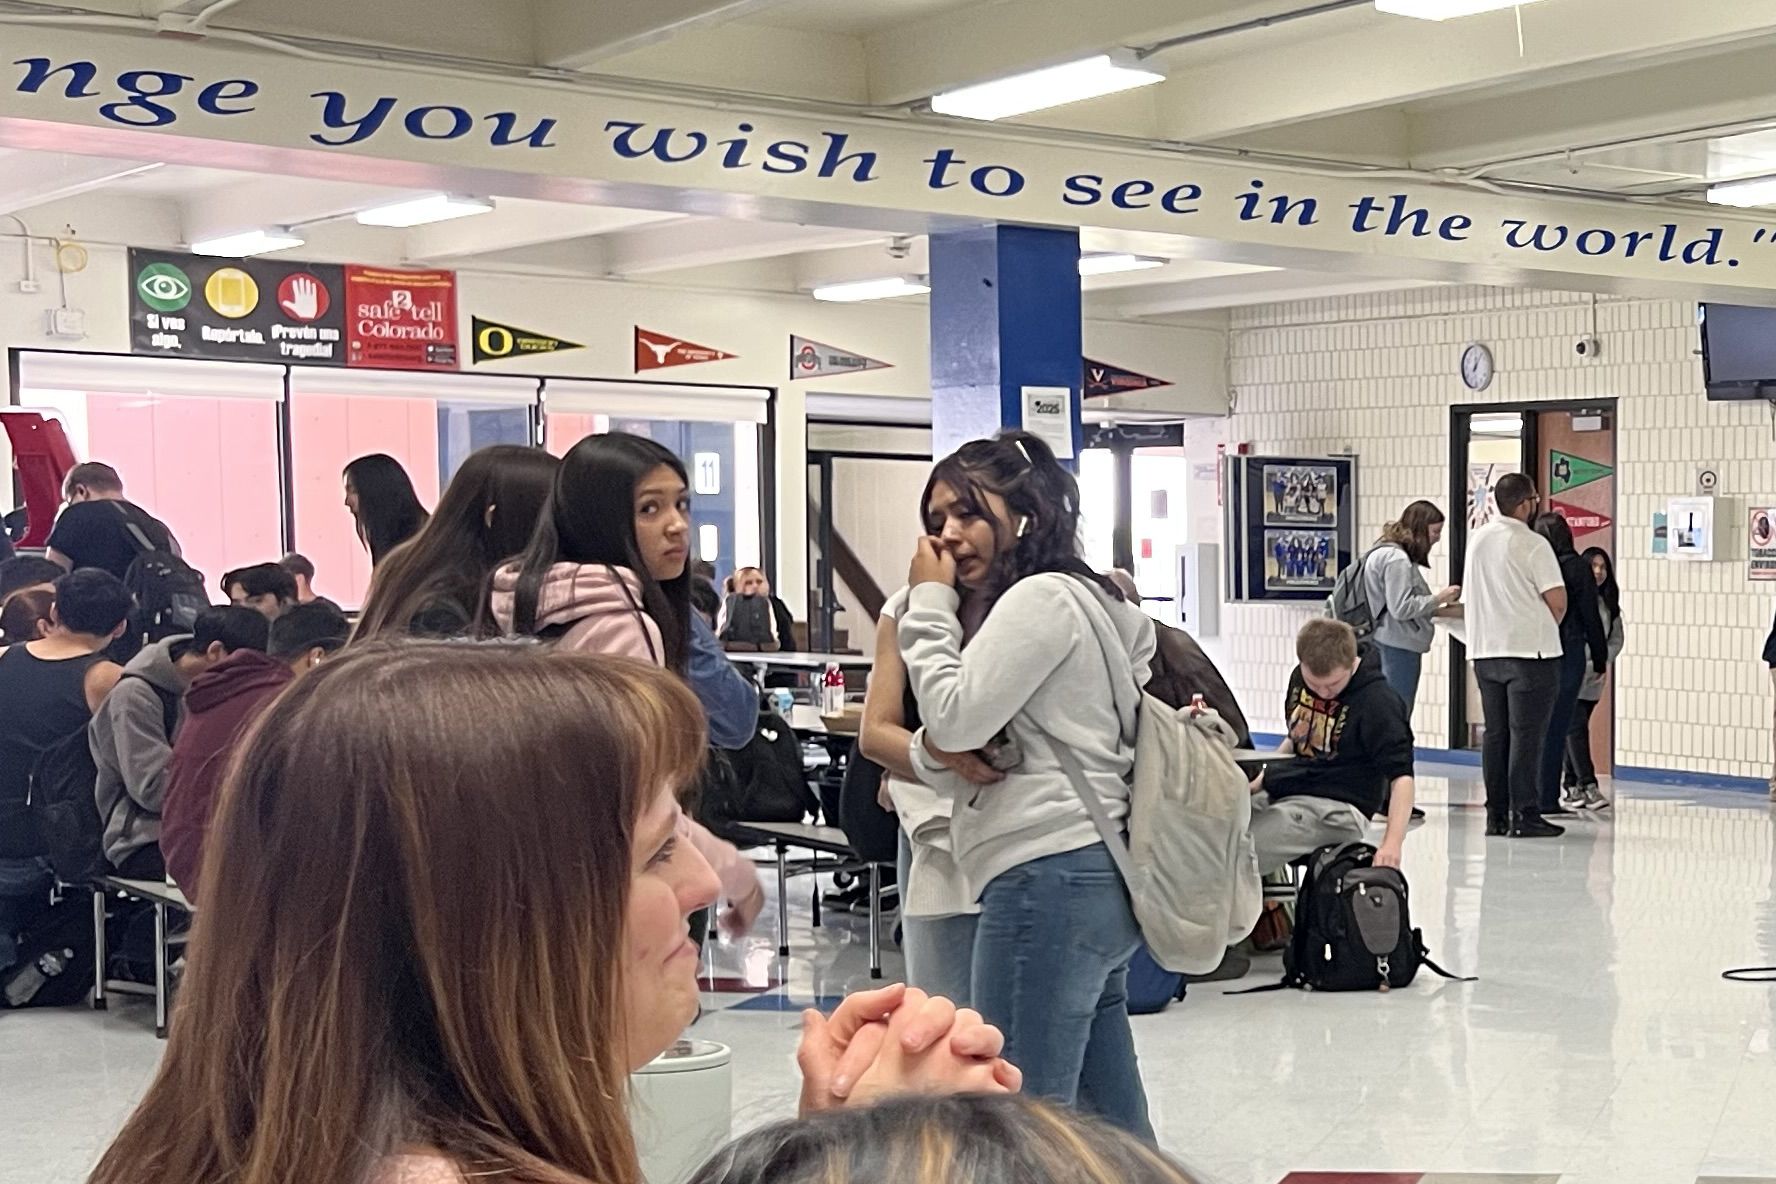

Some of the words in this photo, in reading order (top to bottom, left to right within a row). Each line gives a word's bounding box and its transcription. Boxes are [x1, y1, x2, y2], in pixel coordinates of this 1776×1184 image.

[13, 57, 260, 127] nge
[310, 91, 557, 148] you
[603, 120, 879, 183] wish
[923, 148, 1026, 198] to
[1062, 174, 1202, 214] see
[1234, 179, 1320, 226] in
[1348, 194, 1473, 242] the
[358, 319, 445, 340] Colorado
